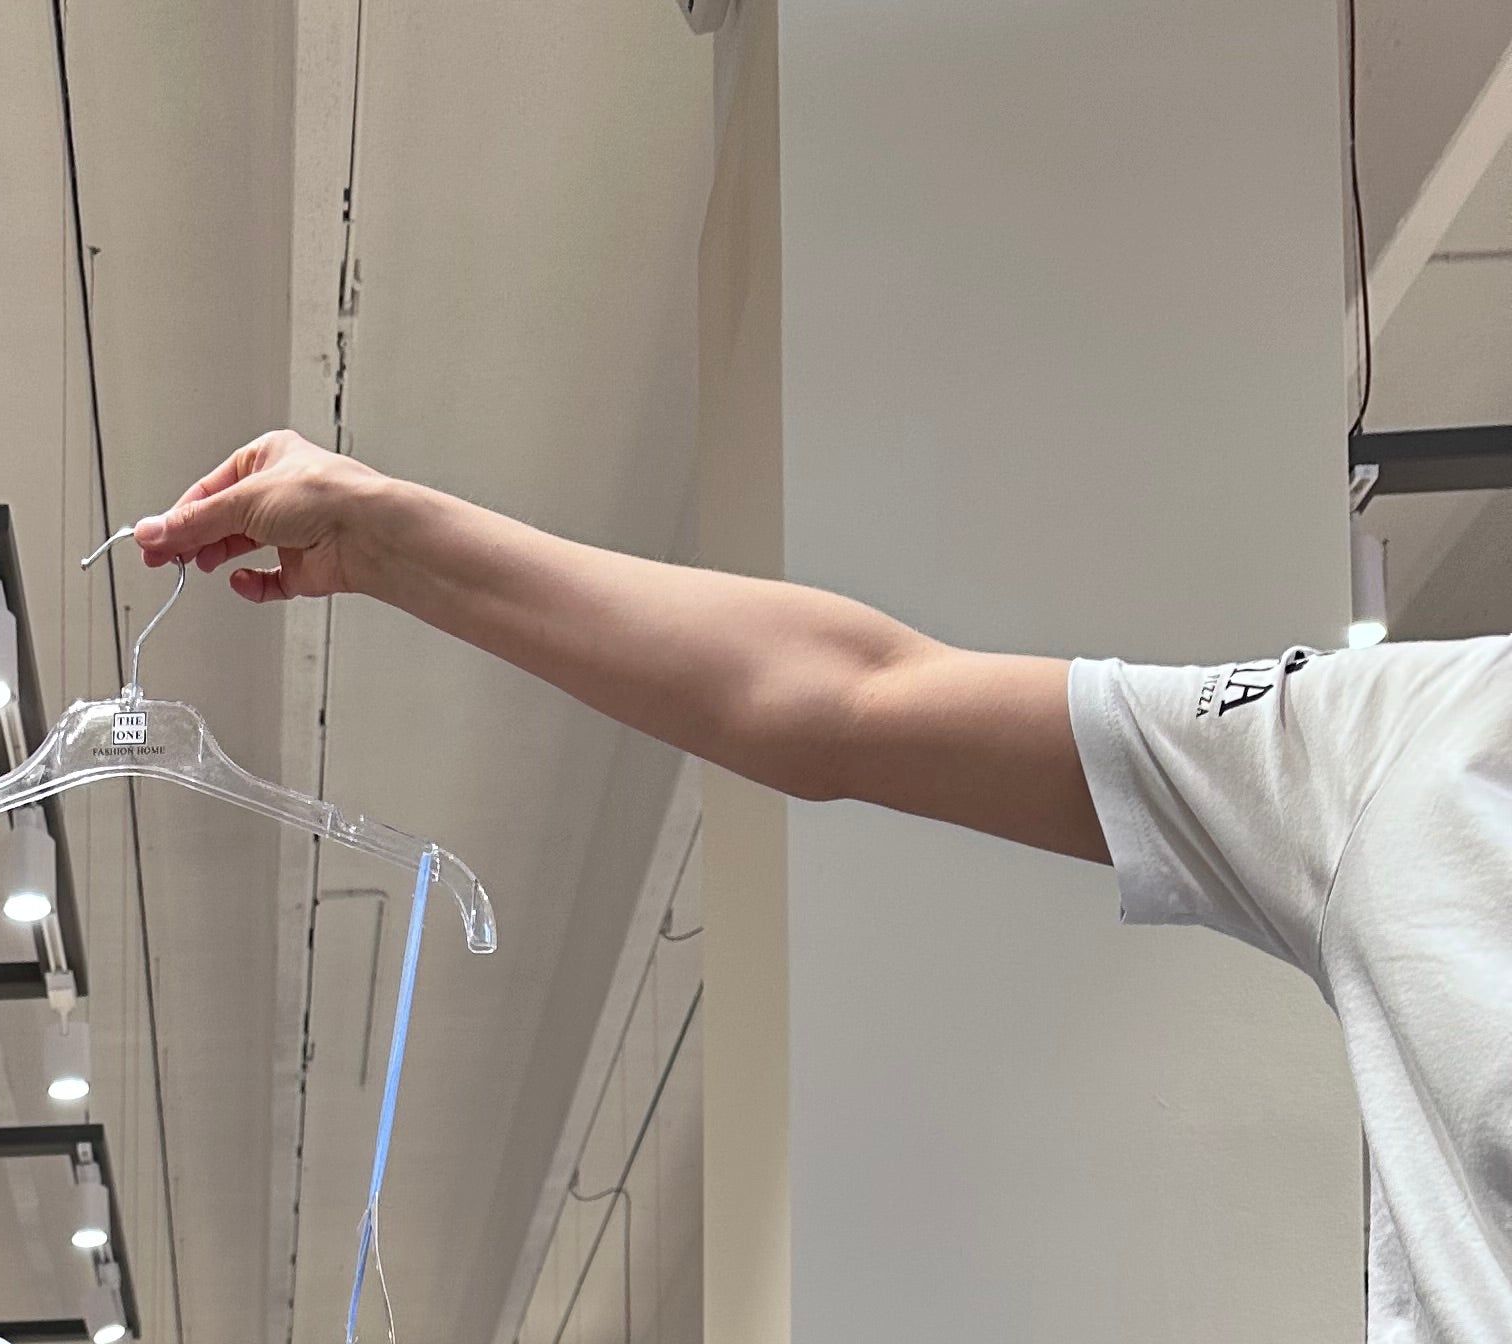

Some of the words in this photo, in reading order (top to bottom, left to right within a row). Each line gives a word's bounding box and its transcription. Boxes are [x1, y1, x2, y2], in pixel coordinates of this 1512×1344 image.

[117, 716, 143, 726] THE
[116, 730, 143, 741] ONE
[92, 746, 134, 756] FASHION
[137, 746, 166, 756] HOME
